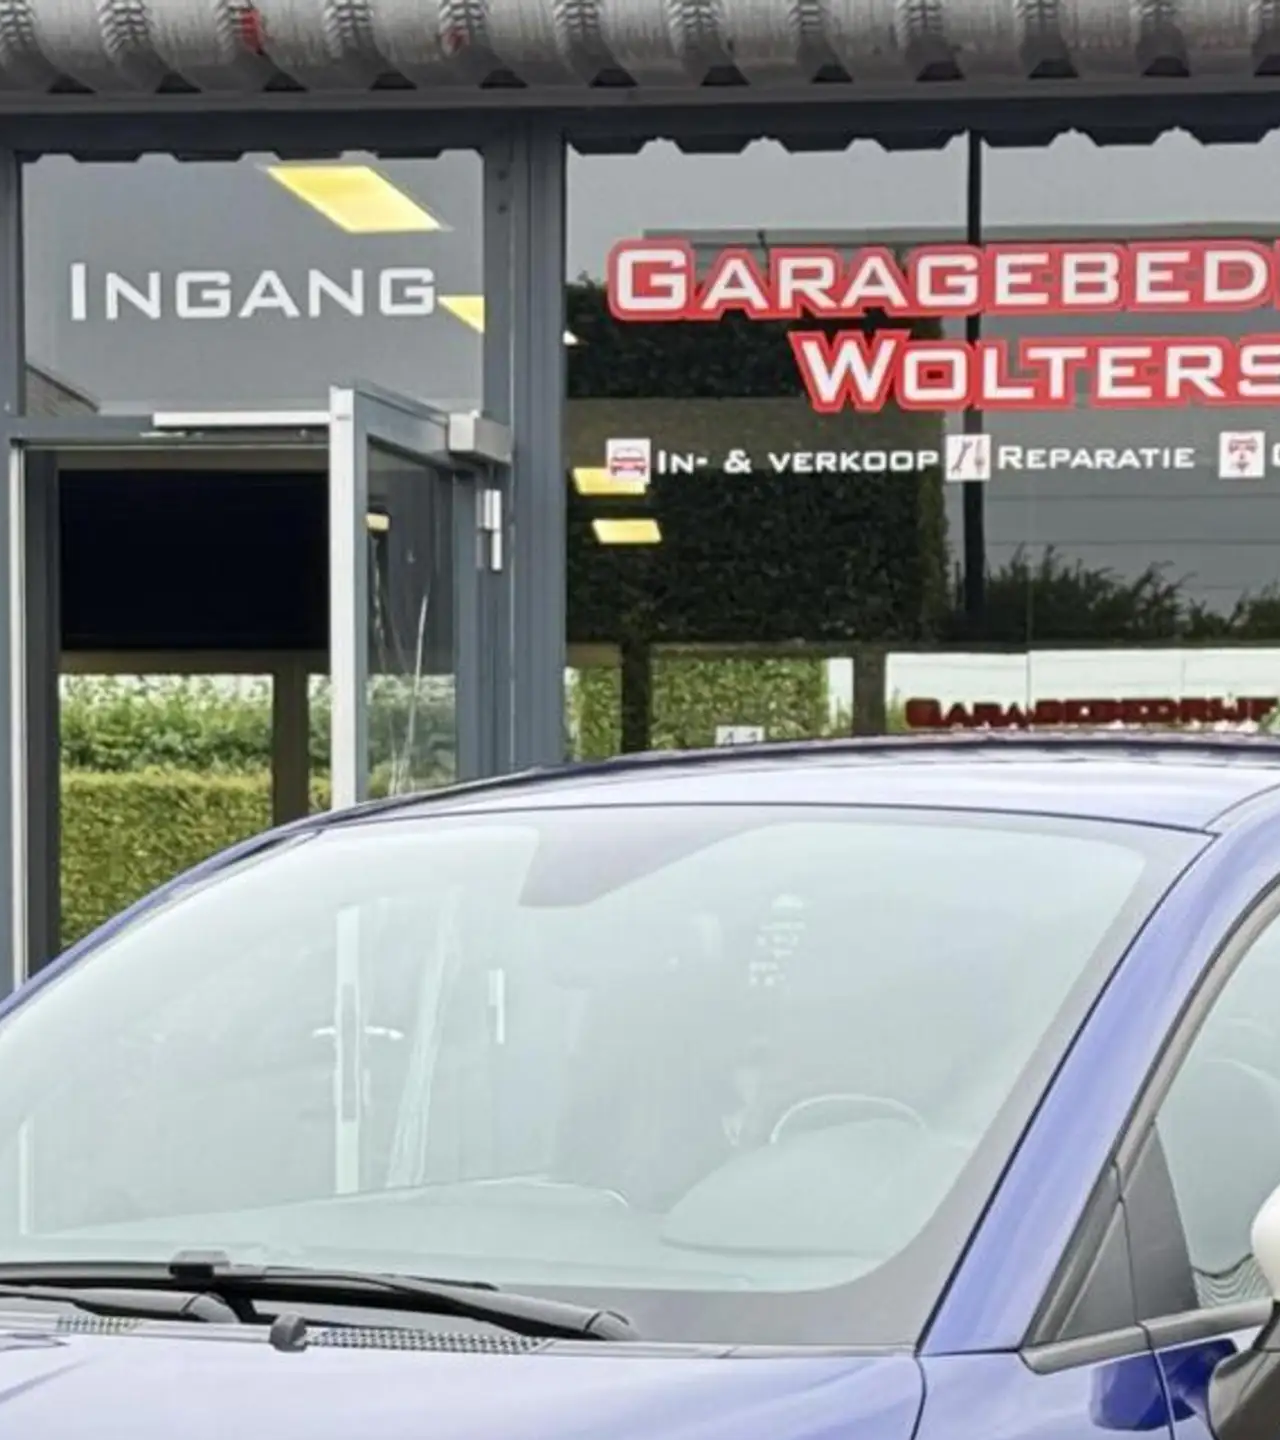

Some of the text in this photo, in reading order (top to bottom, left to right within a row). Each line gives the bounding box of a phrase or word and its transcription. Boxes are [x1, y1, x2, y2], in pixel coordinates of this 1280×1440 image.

[70, 262, 435, 321] INGANG
[723, 449, 752, 472] &
[768, 449, 938, 473] VERKOOP
[997, 446, 1195, 470] REPARATIE
